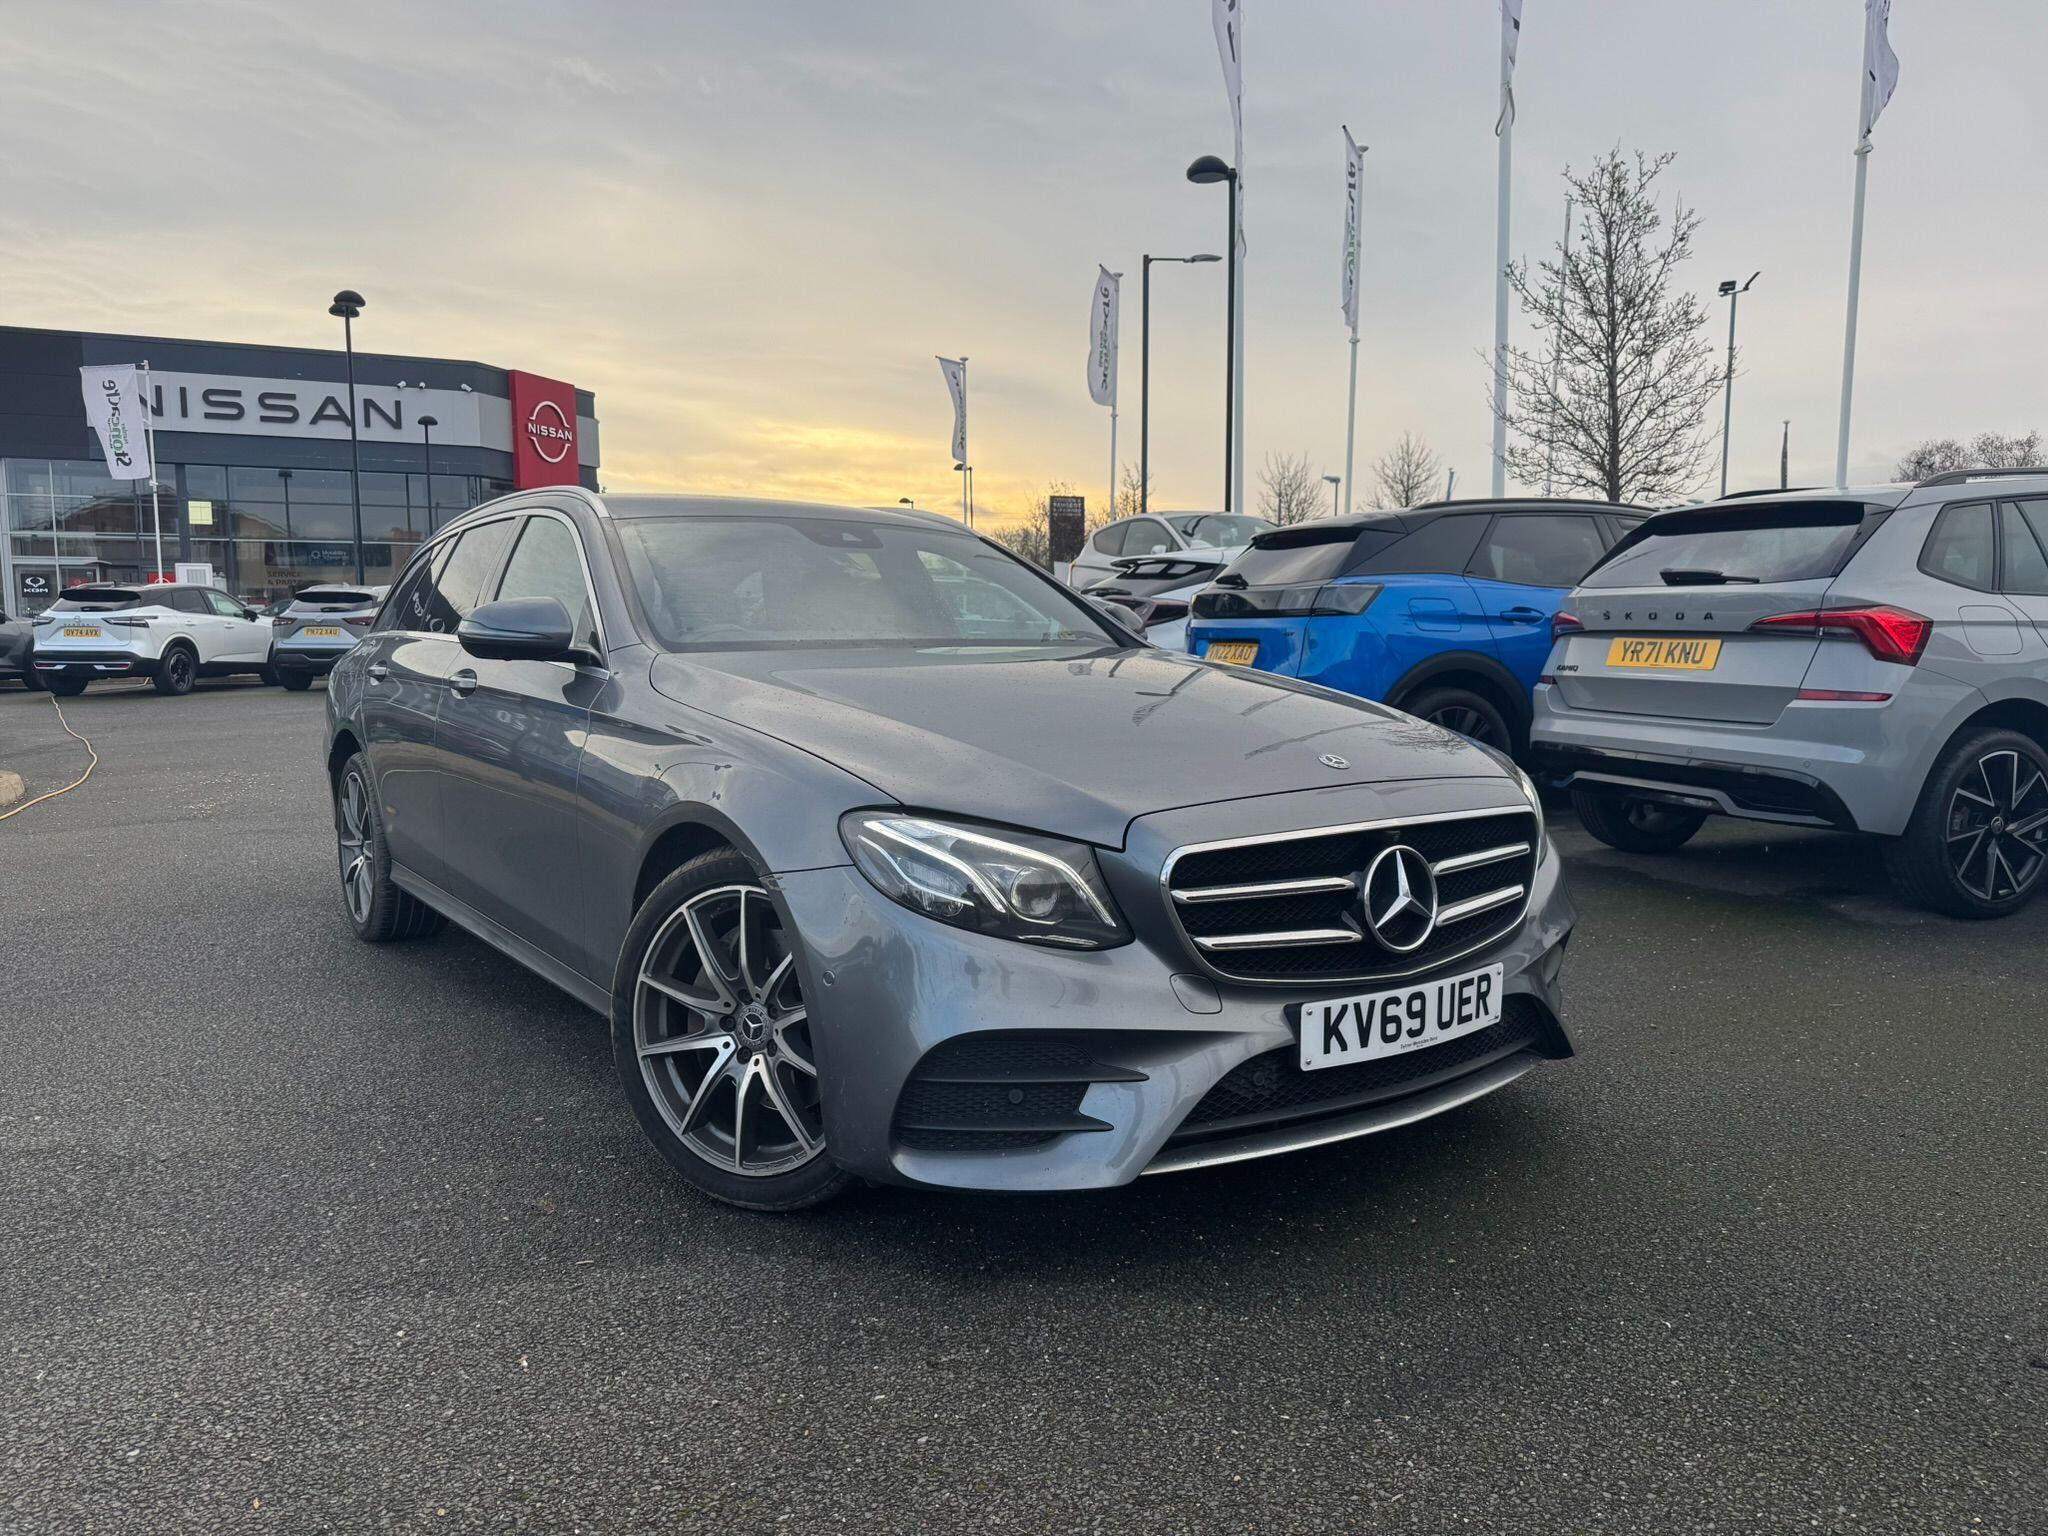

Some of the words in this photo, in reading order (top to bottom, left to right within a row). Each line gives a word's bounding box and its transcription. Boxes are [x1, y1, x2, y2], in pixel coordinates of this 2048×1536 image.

[138, 384, 402, 430] NISSAN
[527, 422, 573, 441] NISSAN
[1621, 641, 1663, 662] YR71
[1664, 642, 1707, 664] KNU
[1323, 990, 1426, 1055] KV69
[1436, 972, 1491, 1031] UER
